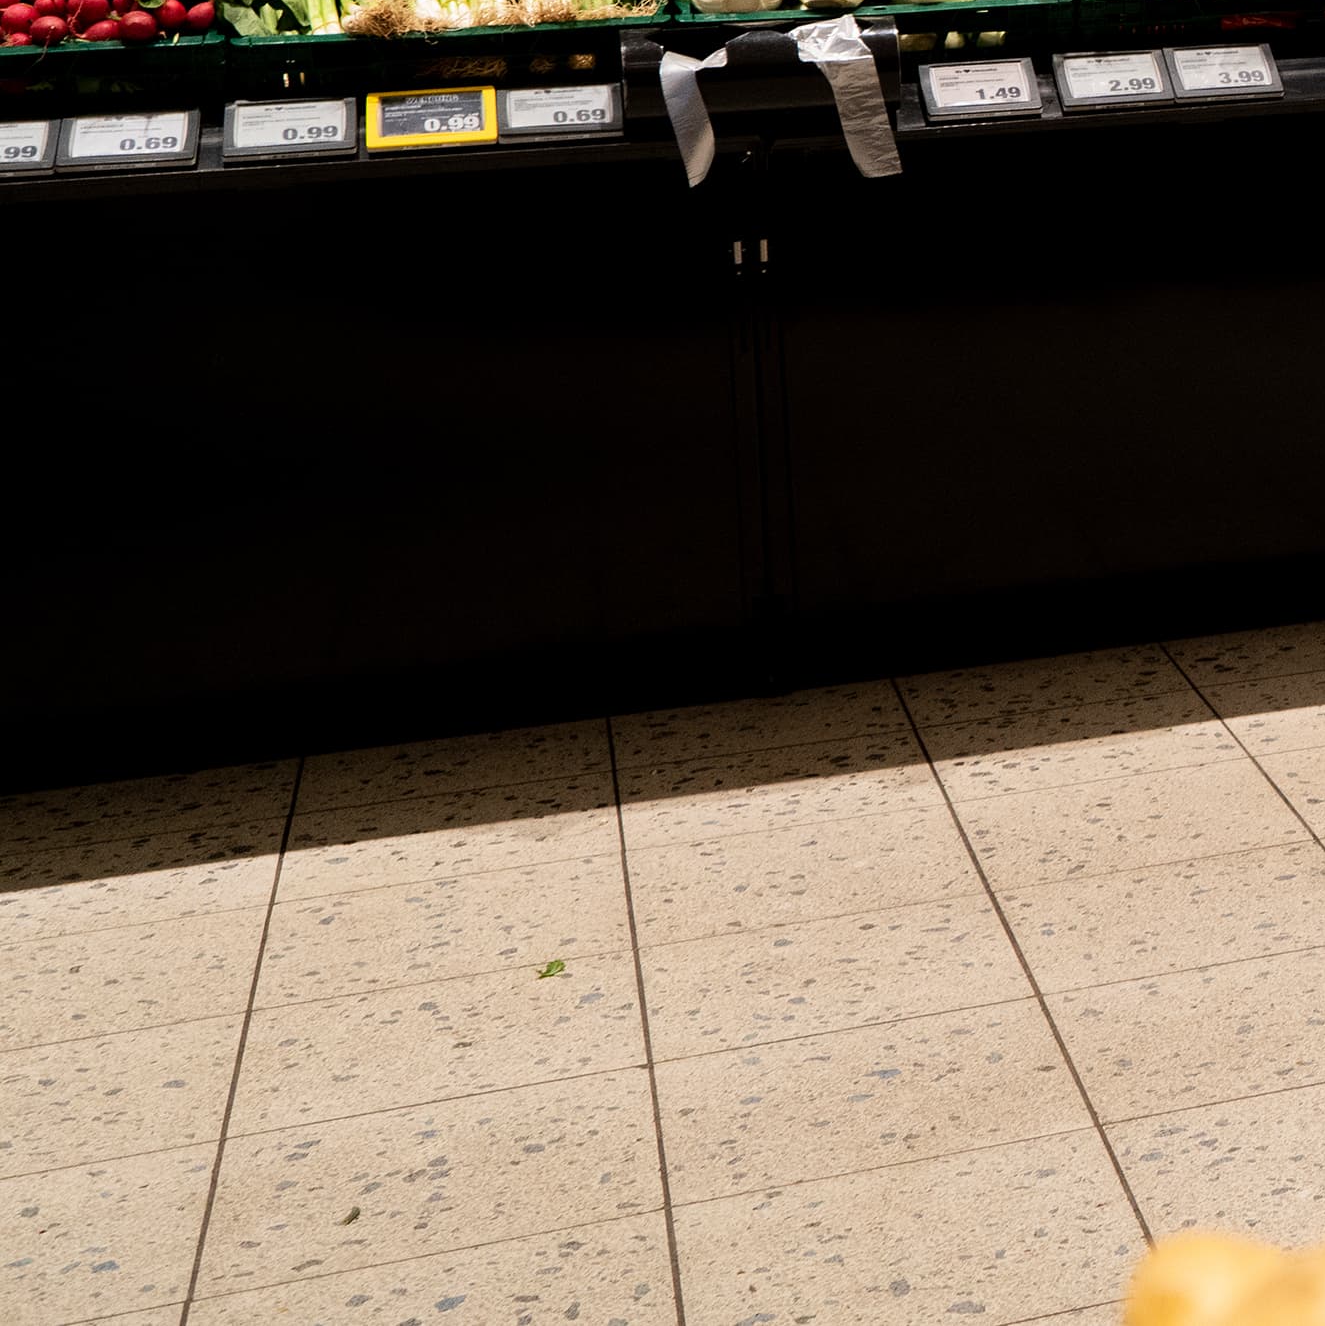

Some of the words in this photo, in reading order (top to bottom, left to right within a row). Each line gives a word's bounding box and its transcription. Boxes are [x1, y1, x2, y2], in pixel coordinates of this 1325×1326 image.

[1109, 76, 1157, 93] 2.99
[1218, 69, 1266, 85] 3.99
[975, 85, 1022, 101] 1.49
[553, 108, 607, 123] 0.69
[423, 115, 480, 133] 0.99
[281, 124, 339, 141] 0.99
[119, 135, 178, 151] 0.69
[0, 145, 37, 159] .99
